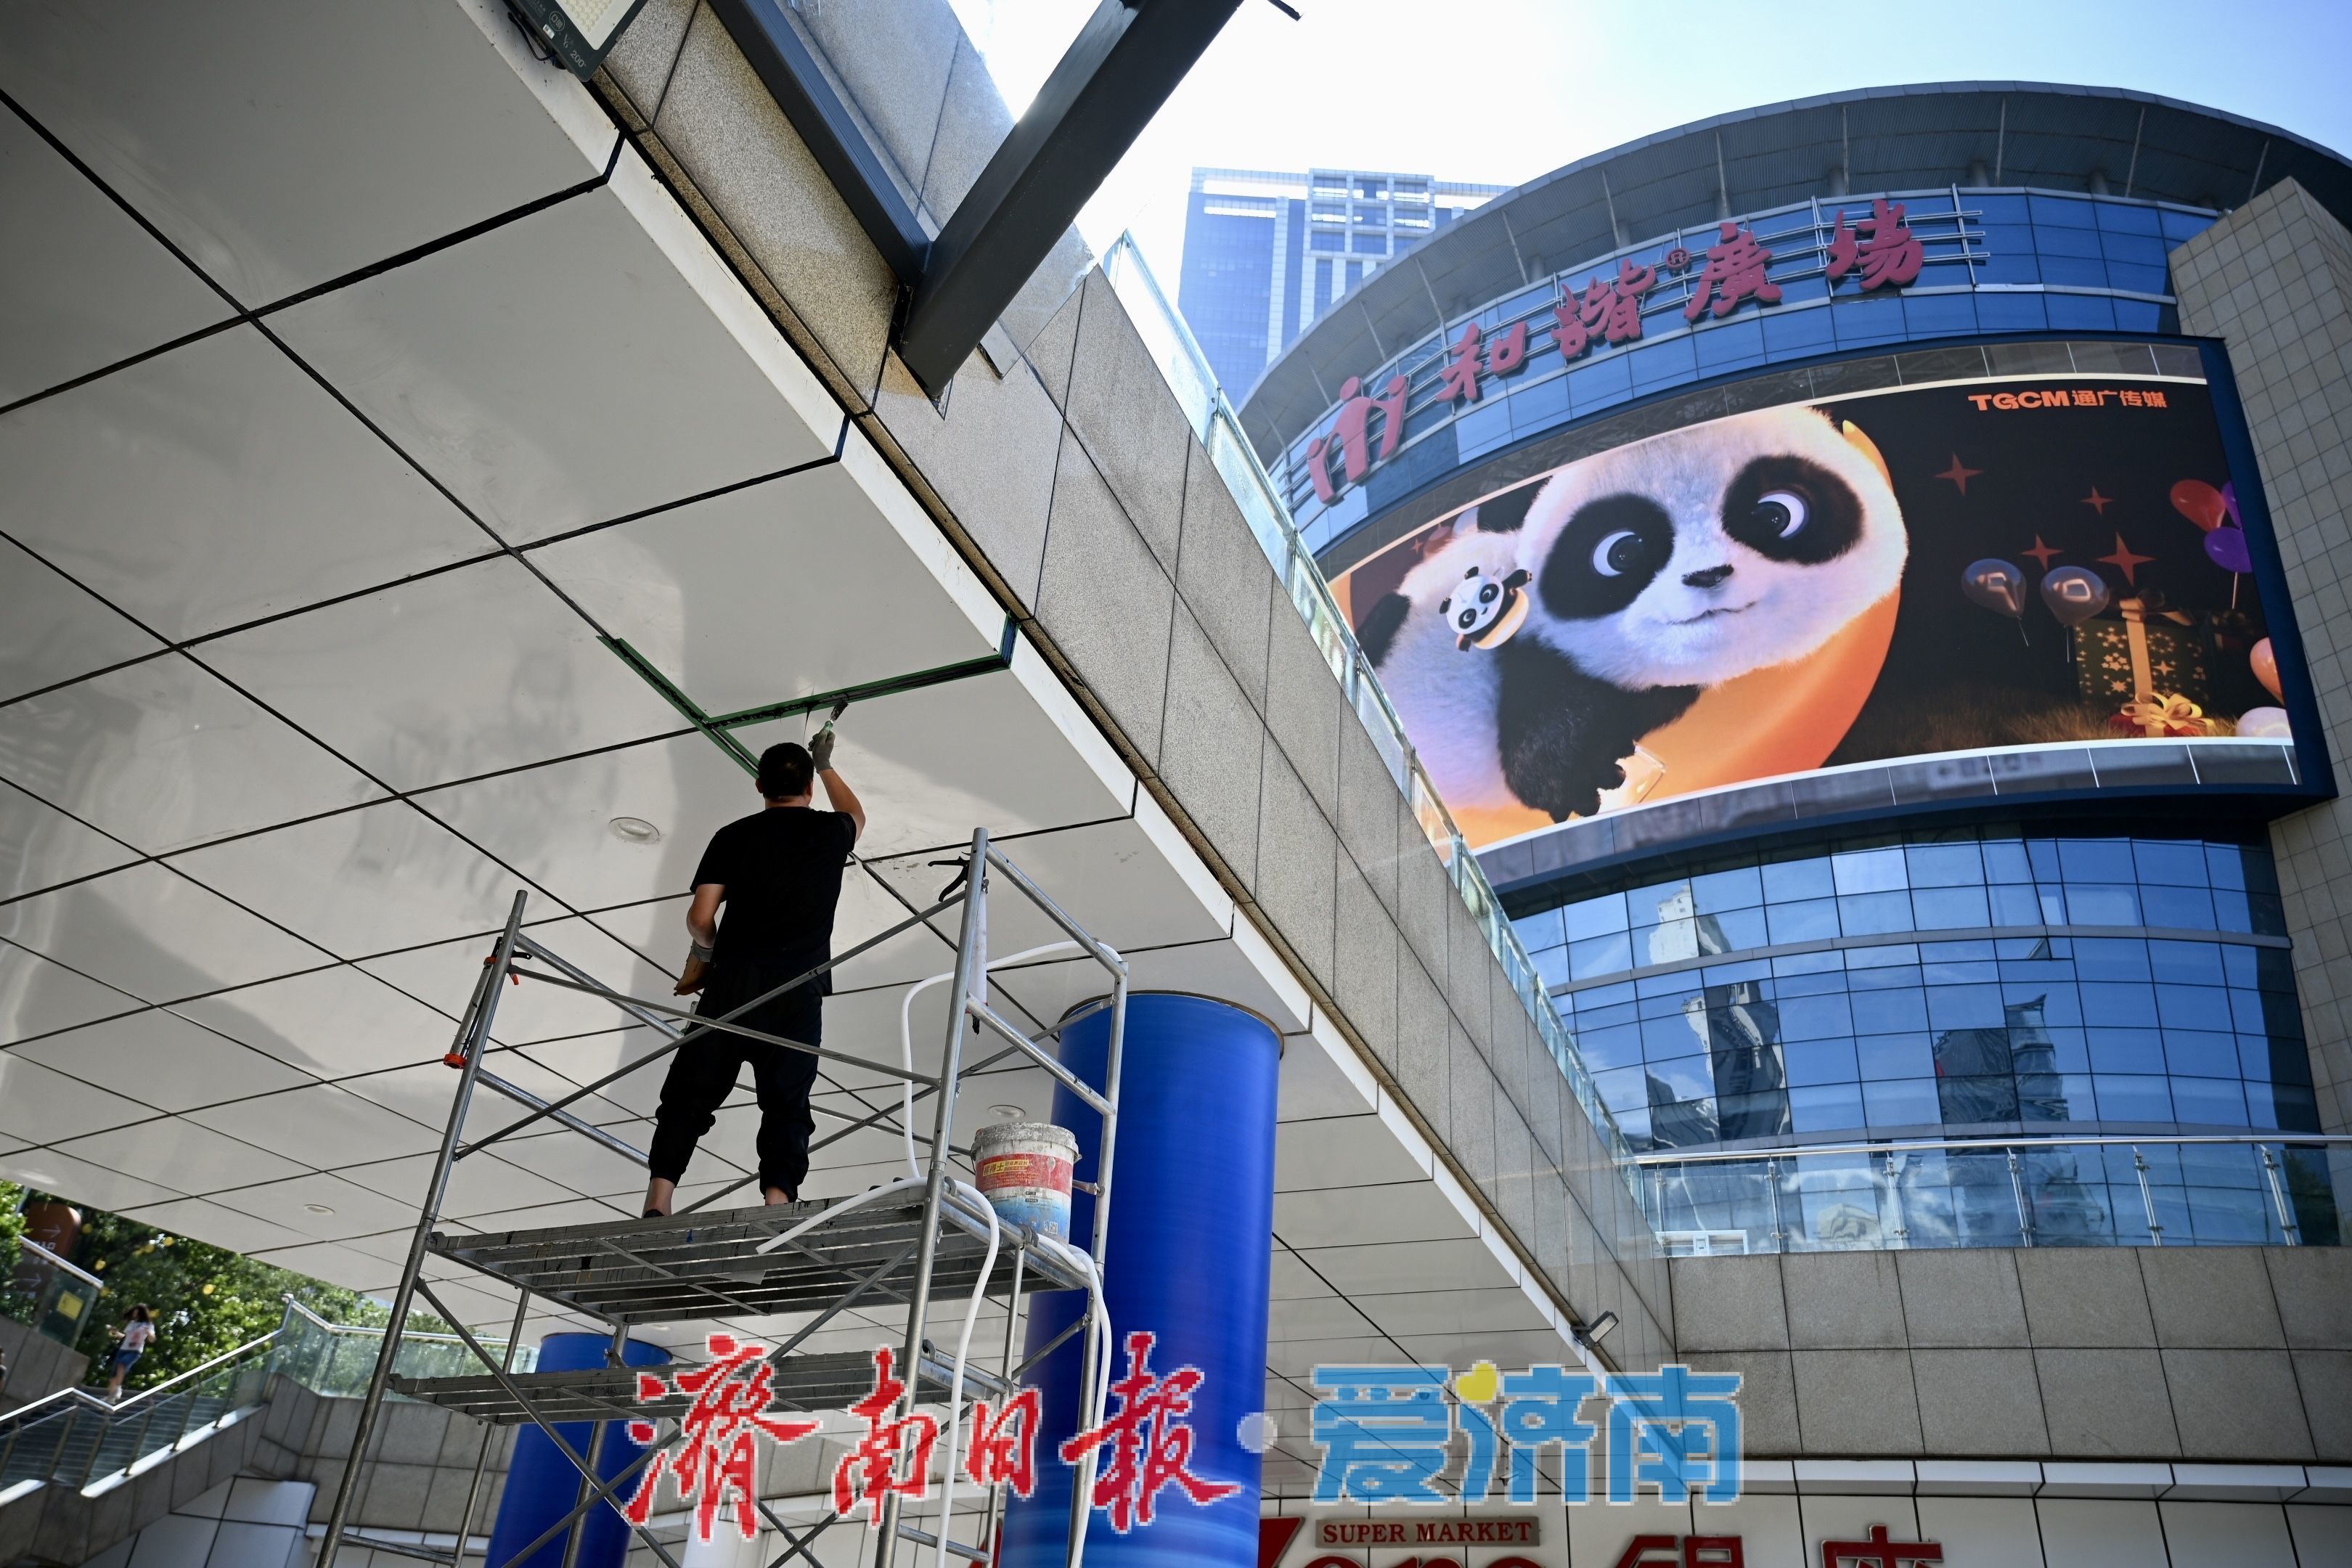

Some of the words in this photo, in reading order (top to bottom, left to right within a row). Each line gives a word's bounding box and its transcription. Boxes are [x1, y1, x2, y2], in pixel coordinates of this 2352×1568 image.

[1968, 391, 2070, 411] TGCM
[2072, 390, 2168, 408] 通广传媒
[1323, 1524, 1407, 1543] SUPER
[1416, 1522, 1532, 1543] MARKET
